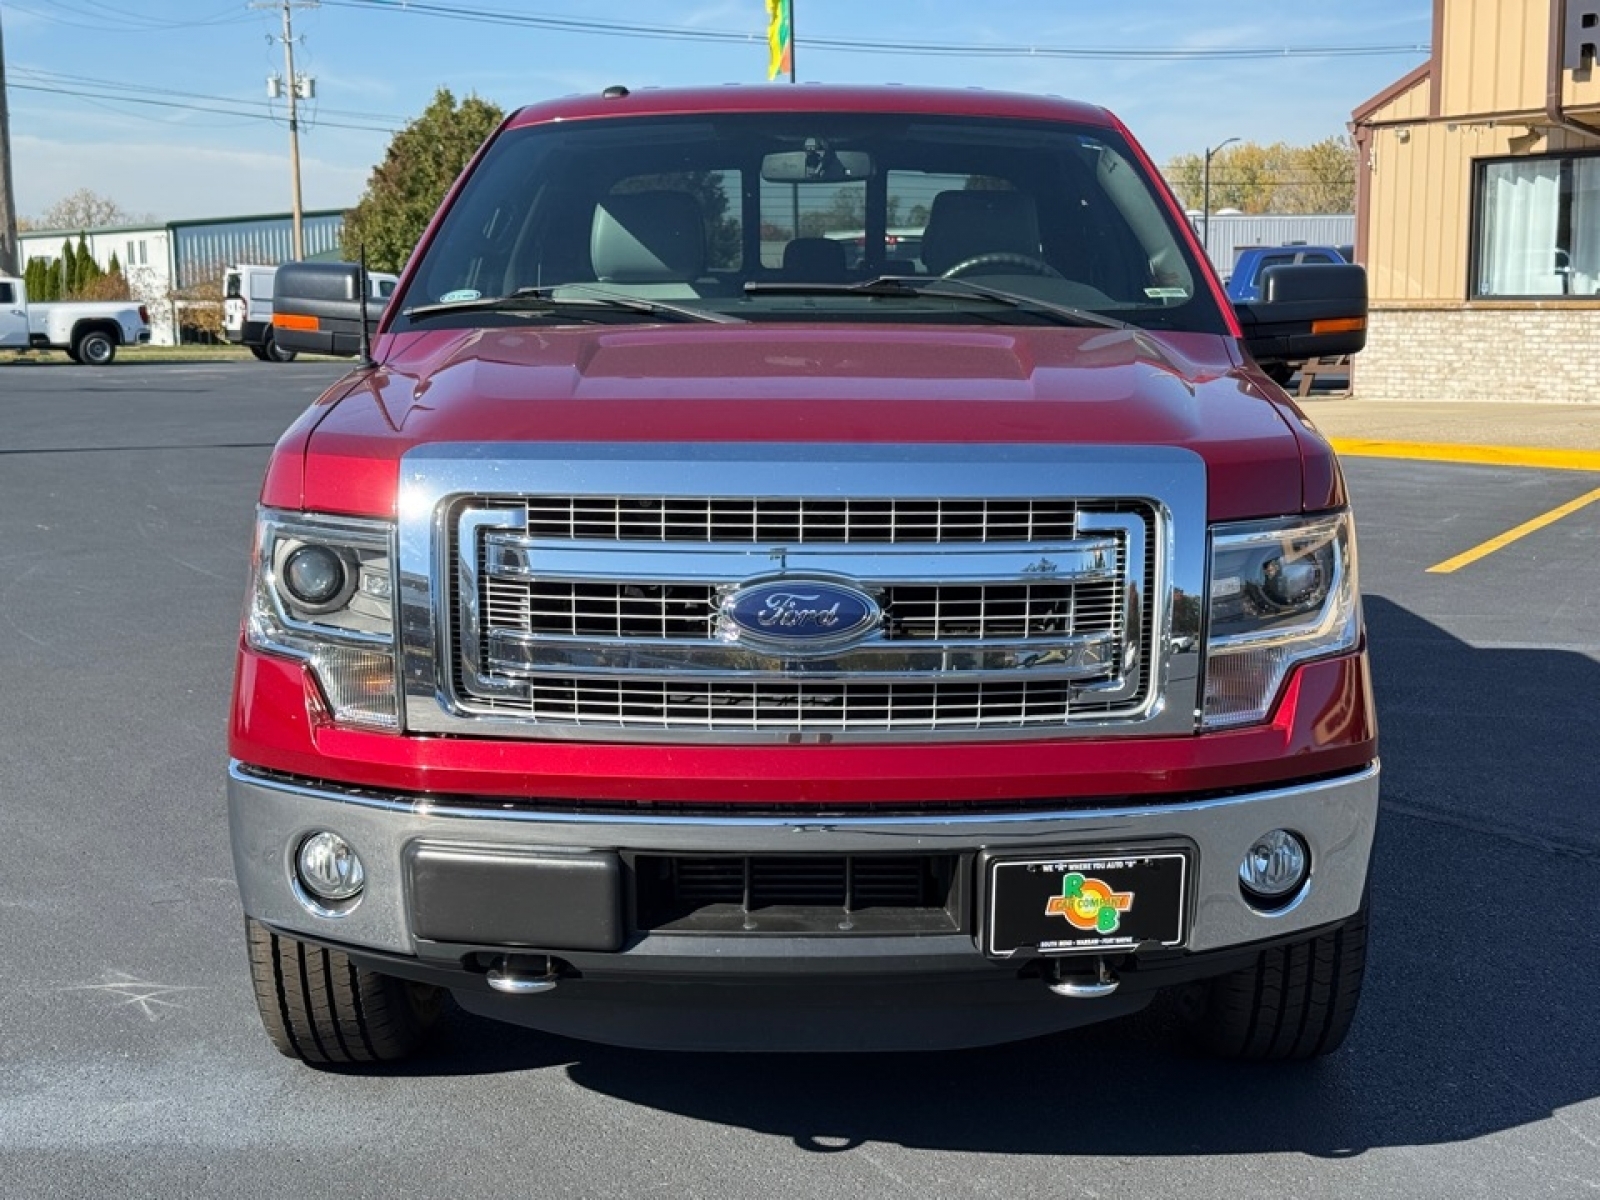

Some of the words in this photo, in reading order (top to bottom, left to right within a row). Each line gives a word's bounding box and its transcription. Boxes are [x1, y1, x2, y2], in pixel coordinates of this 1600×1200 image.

[758, 592, 841, 627] Ford
[1063, 872, 1086, 898] R
[1097, 906, 1119, 933] B
